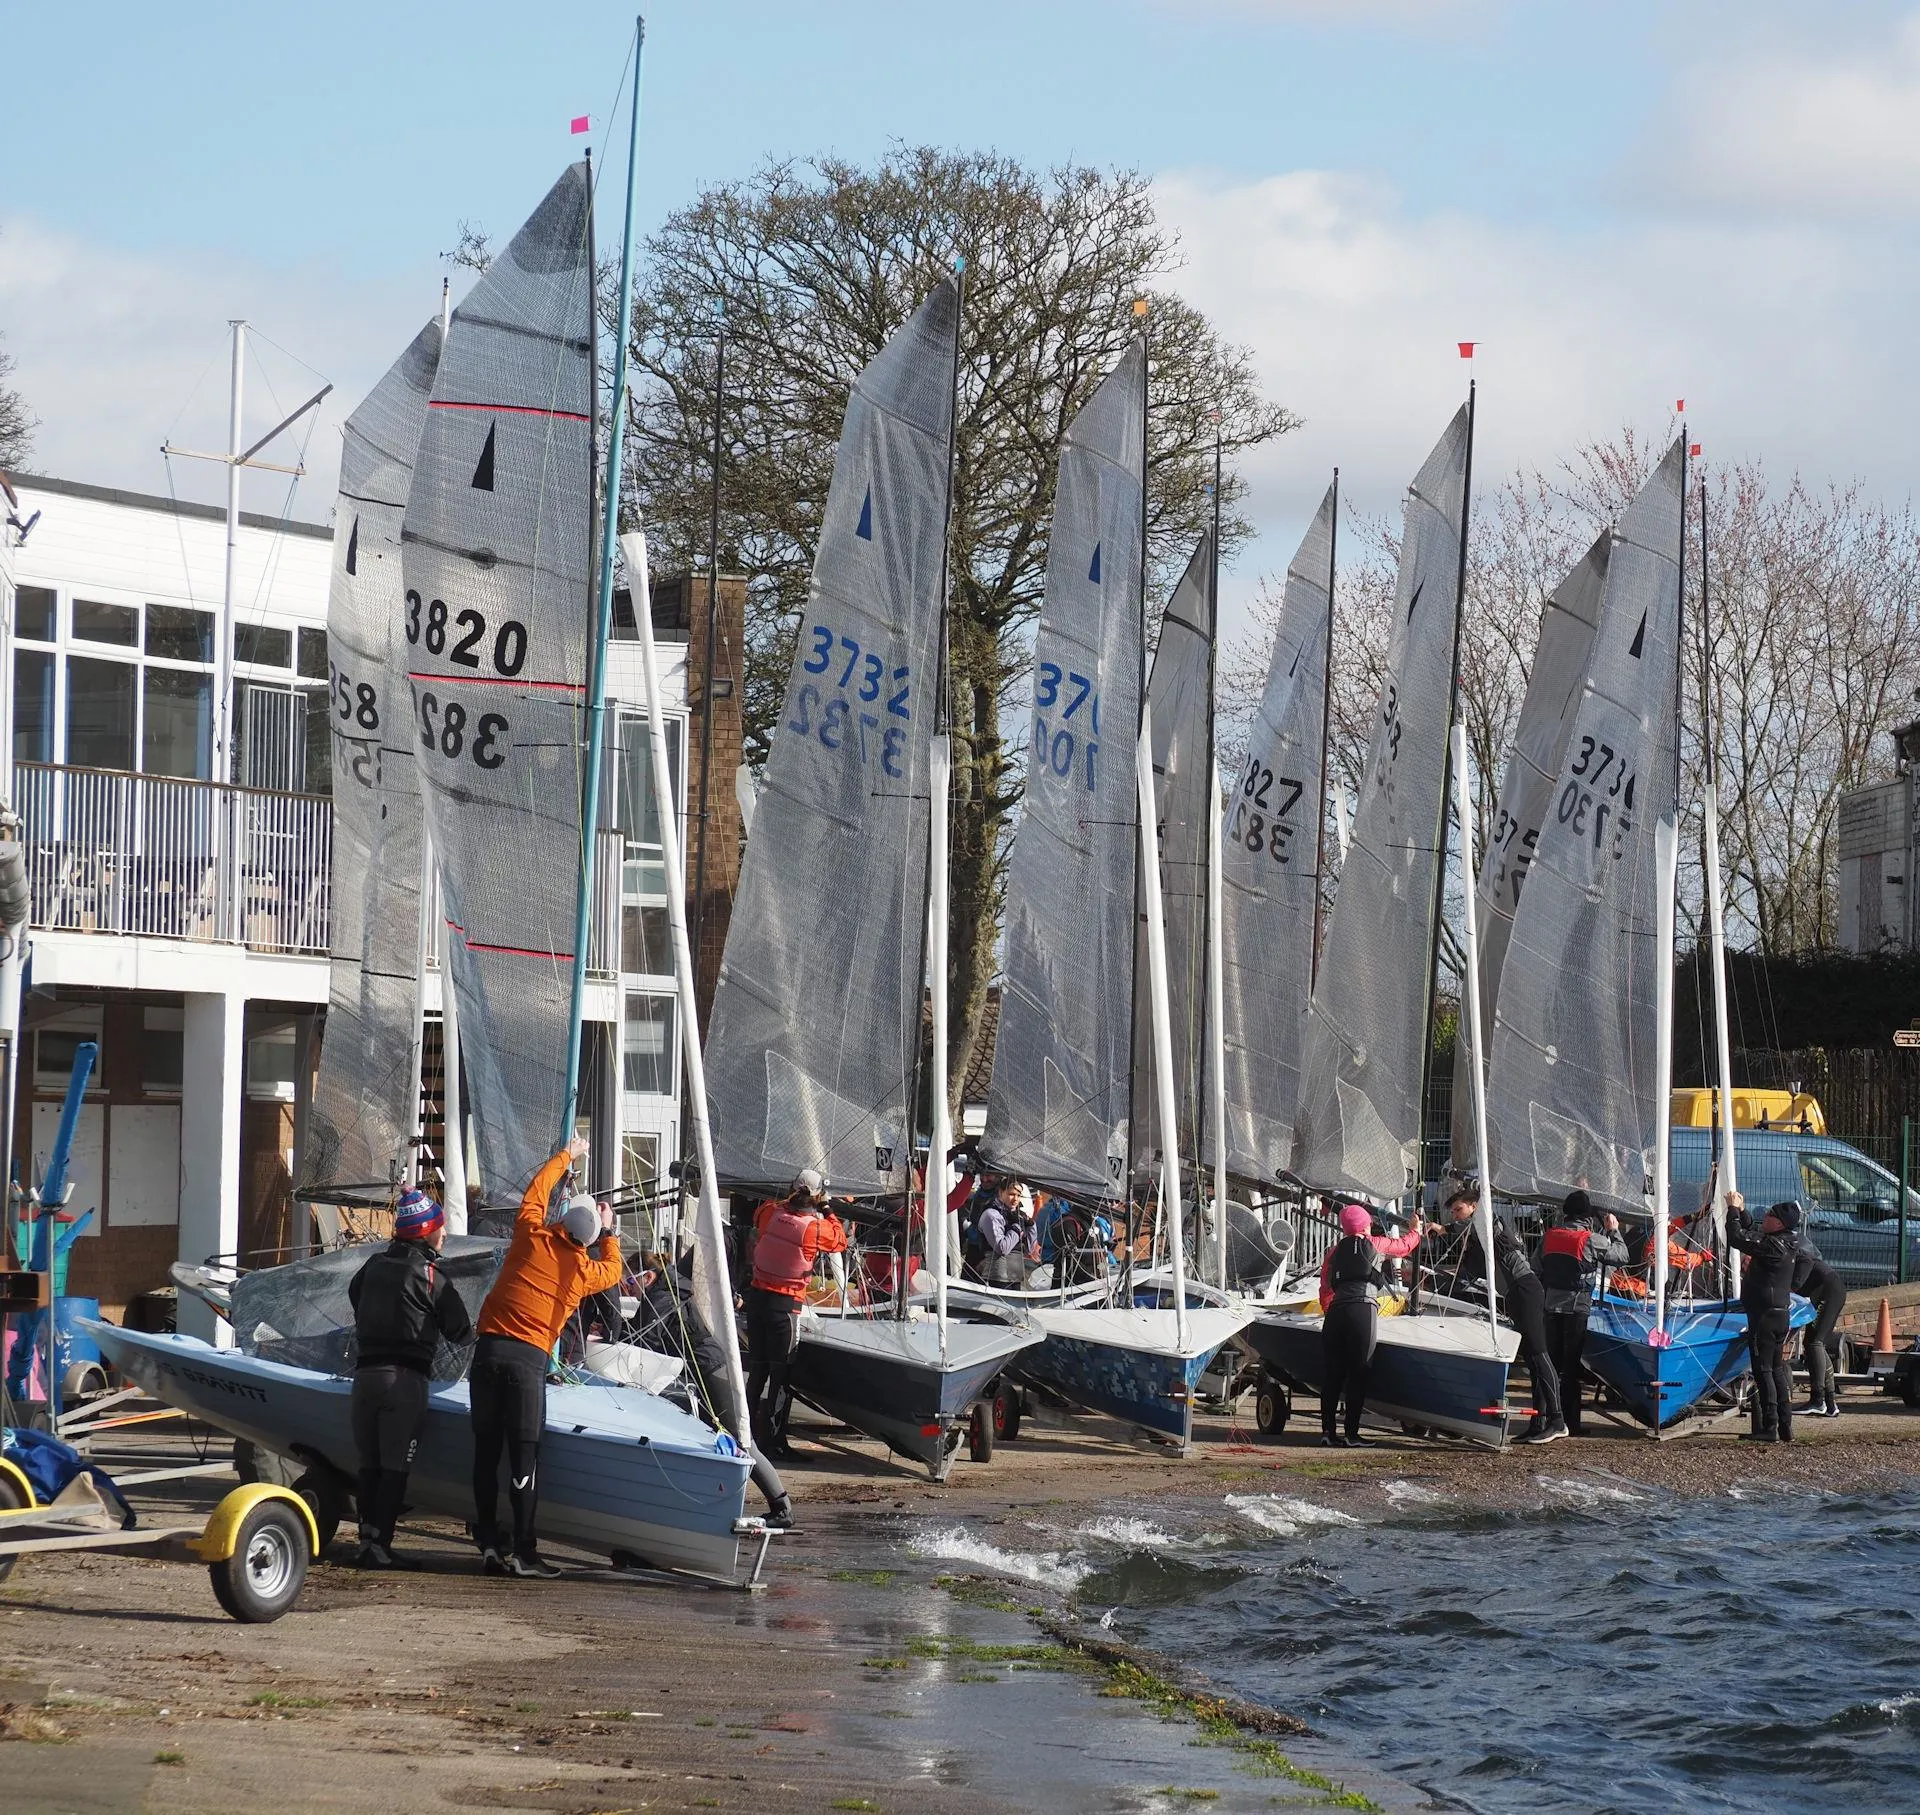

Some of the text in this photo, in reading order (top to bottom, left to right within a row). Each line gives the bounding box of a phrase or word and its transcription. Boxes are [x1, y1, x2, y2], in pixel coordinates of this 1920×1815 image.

[405, 588, 528, 677] 3820
[803, 625, 910, 720] 3732
[1241, 752, 1303, 817] 827
